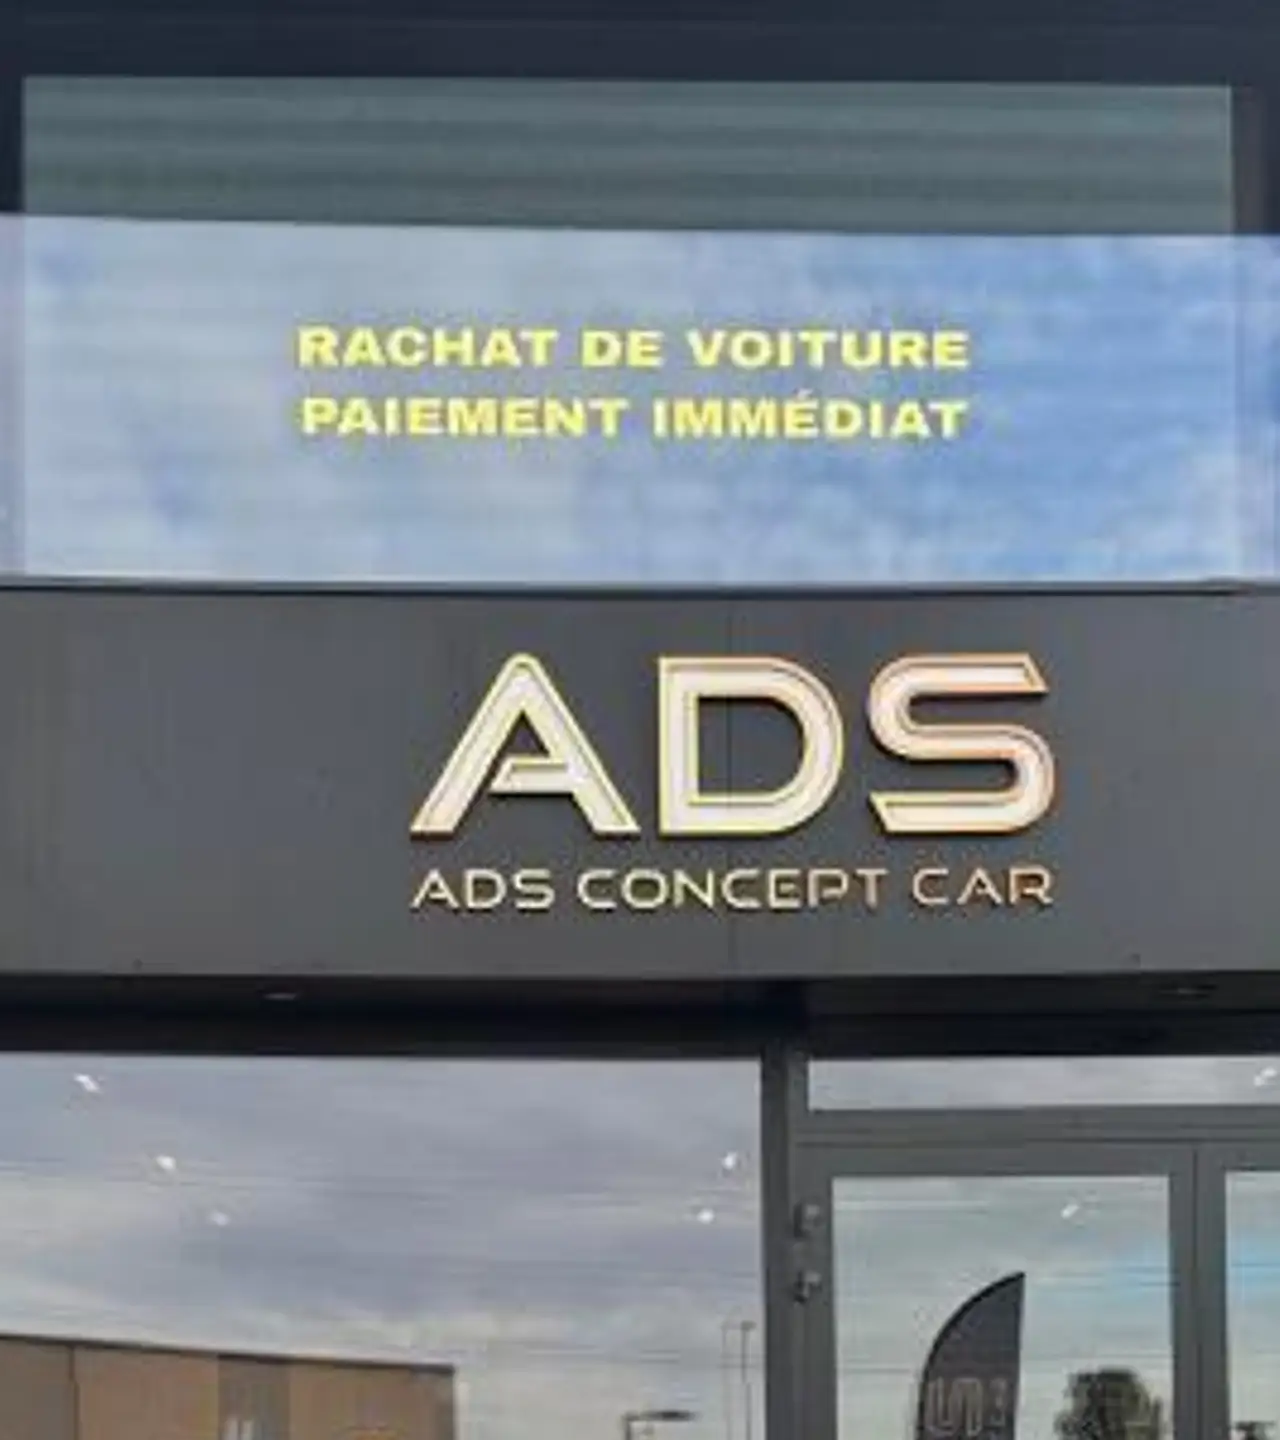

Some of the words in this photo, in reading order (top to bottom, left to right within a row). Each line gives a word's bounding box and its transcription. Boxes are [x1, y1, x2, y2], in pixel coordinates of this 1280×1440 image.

[298, 327, 558, 367] RACHAT
[581, 329, 664, 367] DE
[687, 329, 970, 368] VOITURE
[301, 396, 628, 437] PAIEMENT
[652, 388, 968, 438] IMMÉDIAT
[409, 652, 1056, 836] ADS
[411, 868, 553, 910] ADS
[576, 868, 887, 910] CONCEPT
[912, 865, 1055, 905] CAR
